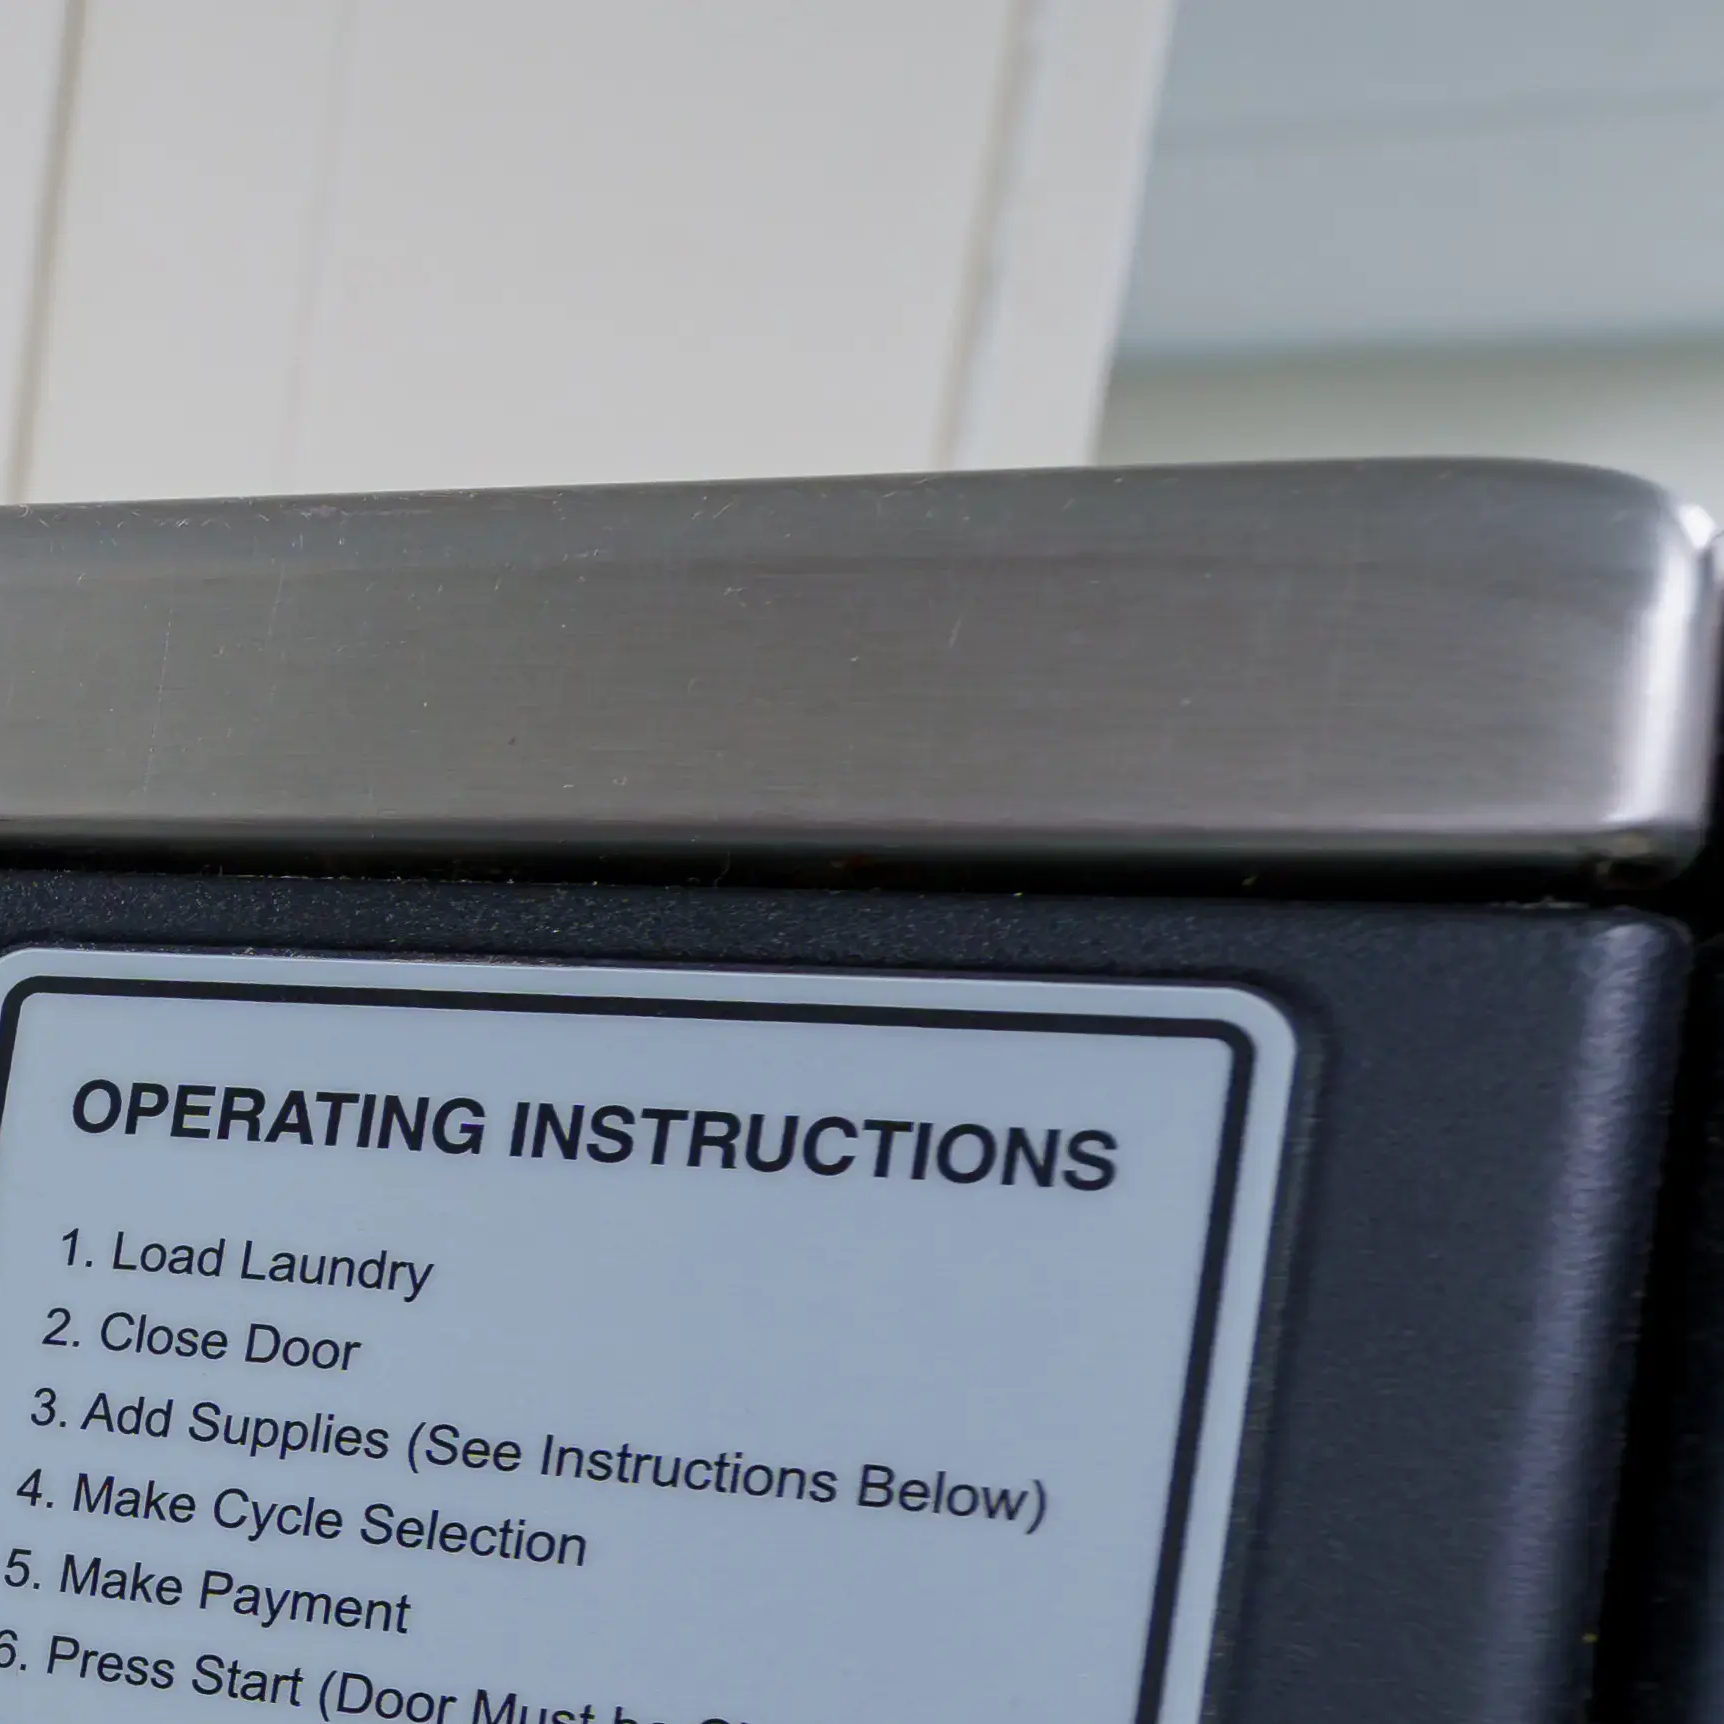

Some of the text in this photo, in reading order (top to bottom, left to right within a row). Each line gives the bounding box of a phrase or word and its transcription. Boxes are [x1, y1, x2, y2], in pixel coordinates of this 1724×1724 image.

[72, 1079, 1118, 1191] OPERATING INSTRUCTIONS
[62, 1228, 435, 1303] 1. Load Laundry
[41, 1307, 362, 1371] 2. Close Door
[31, 1387, 1048, 1535] 3. Add Supplies (See Instructions Below)
[16, 1468, 587, 1566] 4. Make Cycle Selection
[4, 1548, 411, 1634] 5. Make Payment
[47, 1635, 175, 1689] Press
[192, 1654, 304, 1707] Start
[319, 1670, 458, 1724] (Door
